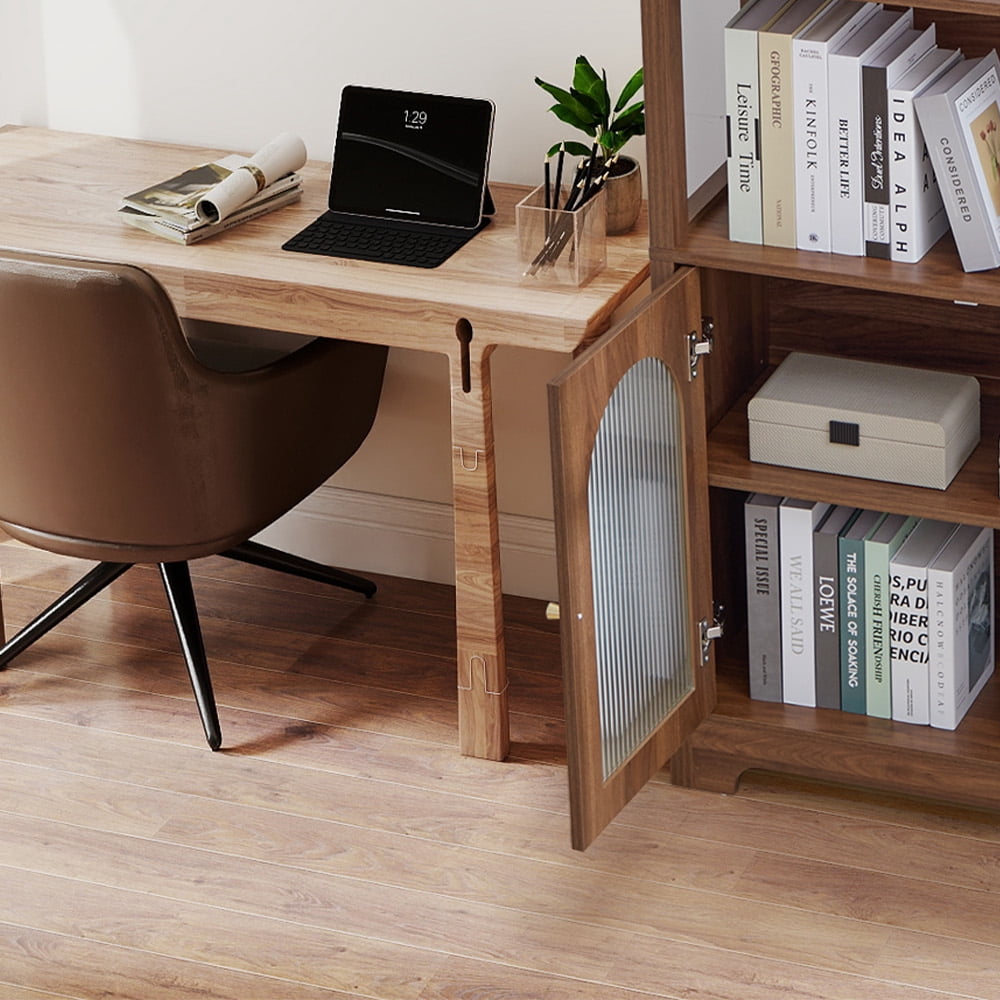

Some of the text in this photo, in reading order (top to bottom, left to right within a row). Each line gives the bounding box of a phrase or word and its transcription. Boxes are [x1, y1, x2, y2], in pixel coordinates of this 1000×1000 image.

[403, 109, 428, 125] 1:29
[957, 73, 997, 113] CONSIDERED
[736, 83, 754, 193] Leisure Time
[805, 98, 818, 170] KINFOLK
[838, 118, 850, 199] BETTER LIFE
[892, 98, 908, 253] IDEA ALPH
[940, 137, 972, 223] CONSIDERED
[754, 518, 770, 596] SPECIAL ISSUE
[790, 617, 805, 656] SAID
[819, 575, 835, 633] LOEWE
[846, 552, 859, 688] THE SOLACE OF SOAKING
[872, 574, 883, 684] CHERISH FRIENDSHIP
